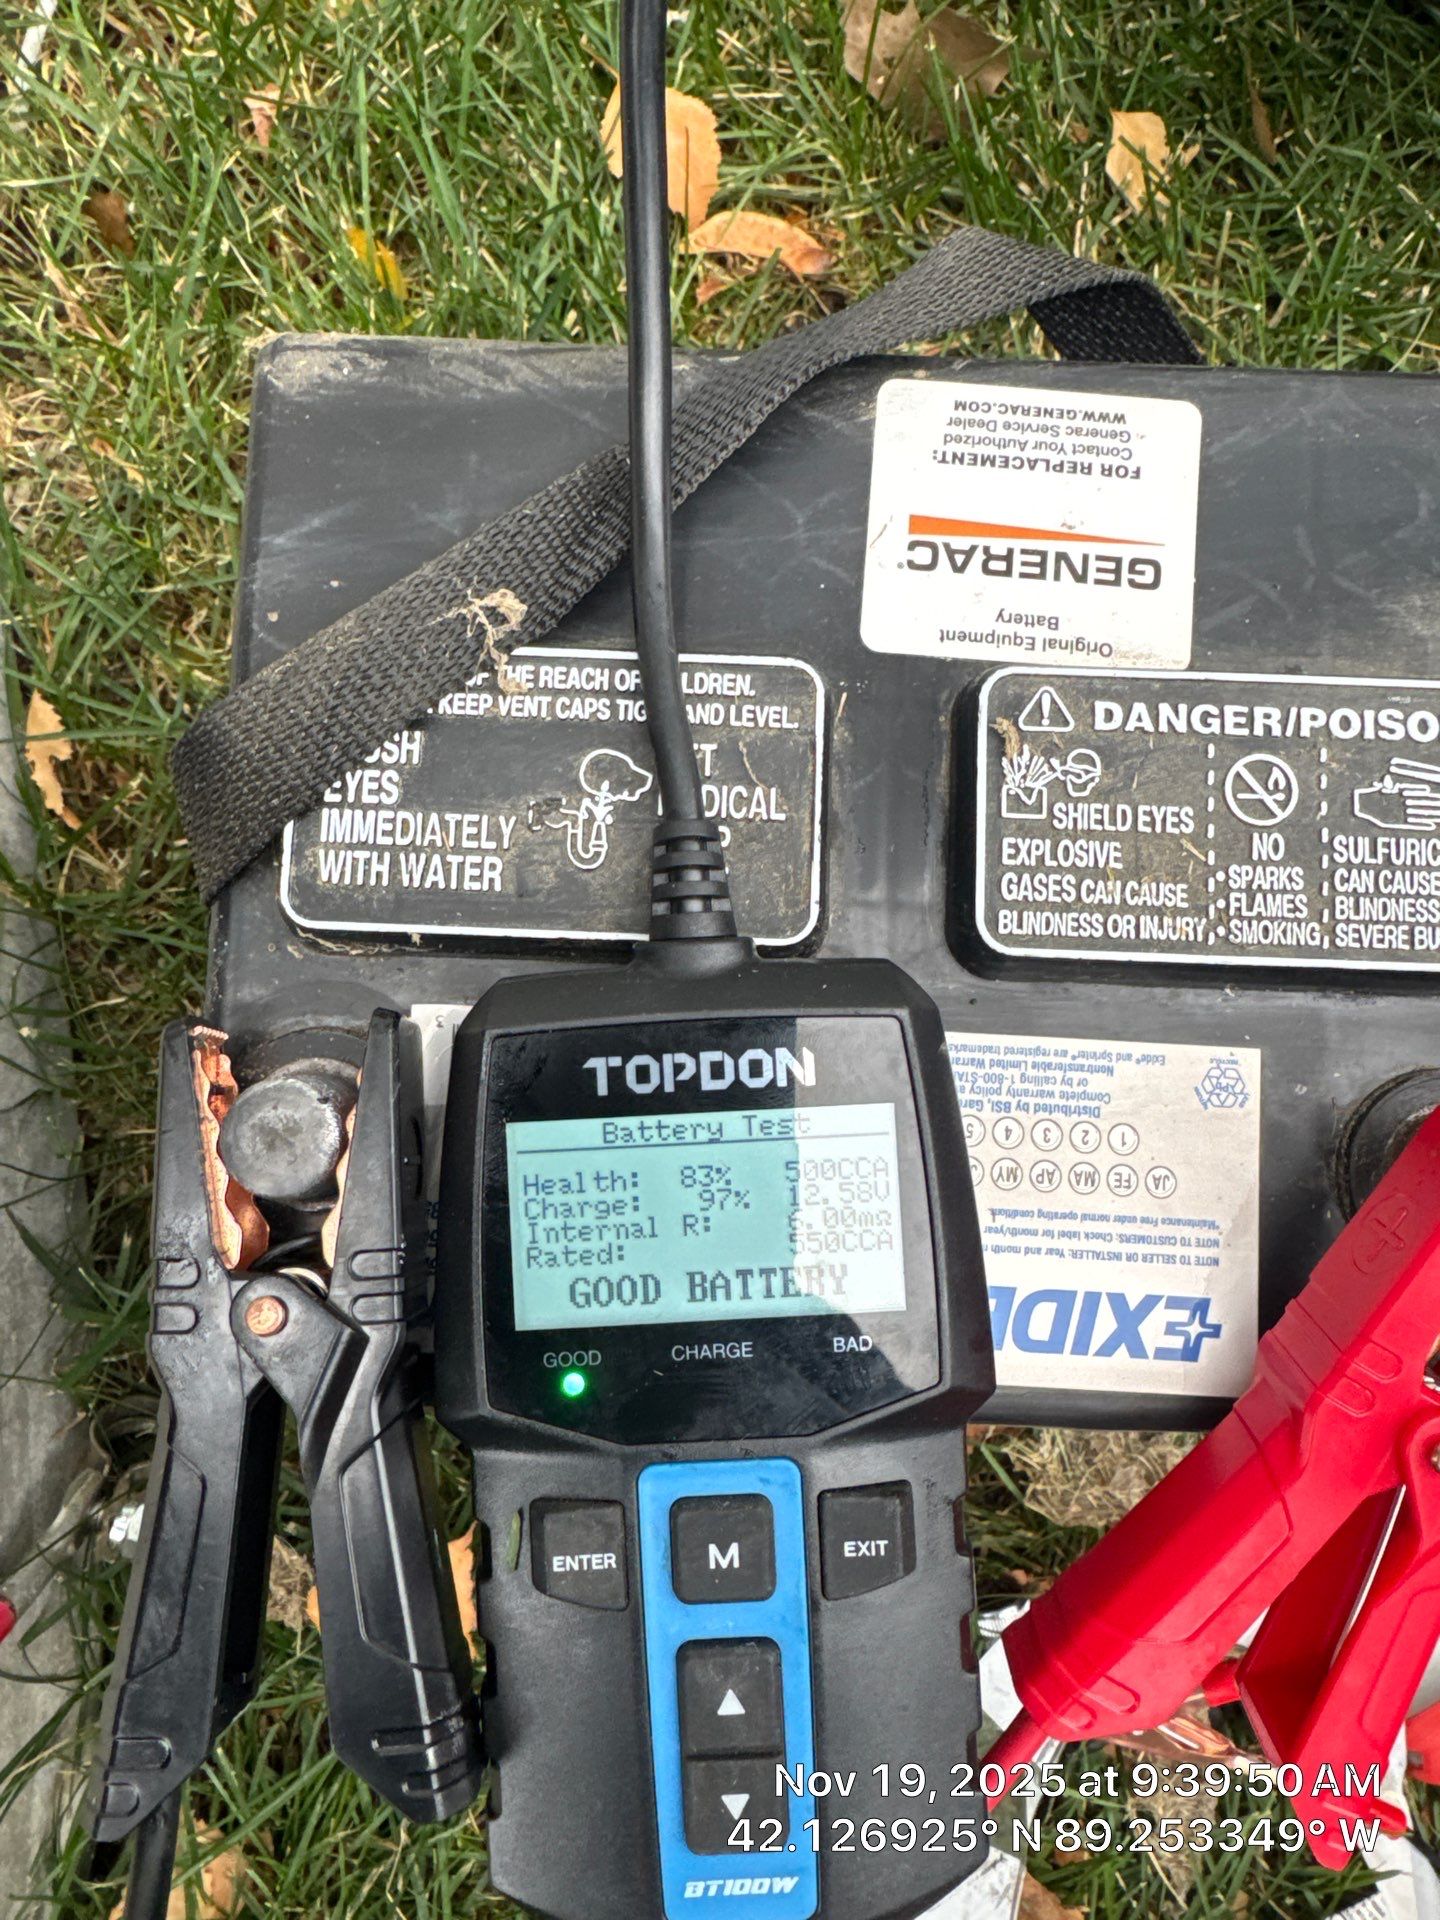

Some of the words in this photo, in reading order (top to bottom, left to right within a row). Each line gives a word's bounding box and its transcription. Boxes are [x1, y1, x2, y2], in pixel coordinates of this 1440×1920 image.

[954, 399, 1127, 424] WWW.GENERAC.COM
[946, 416, 997, 433] Dealer
[1002, 420, 1060, 437] Service
[943, 433, 1028, 451] Authorized
[1065, 426, 1131, 443] Generac
[1031, 440, 1067, 455] Your
[1072, 443, 1133, 460] Contact
[932, 449, 1093, 475] REPLACEMENT:
[1099, 464, 1141, 480] FOR
[996, 608, 1059, 630] Battery
[939, 629, 1036, 651] Equipment
[1042, 637, 1113, 657] Original
[539, 665, 609, 691] REACH
[681, 672, 756, 697] LDREN.
[438, 693, 493, 716] KEEP
[498, 695, 552, 719] VENT
[555, 697, 611, 721] CAPS
[616, 699, 648, 722] TIG
[729, 705, 799, 729] LEVEL.
[1093, 700, 1440, 743] DANGER/POISO
[657, 784, 787, 821] DICAL
[1052, 802, 1133, 832] SHIELD
[1137, 805, 1195, 834] EYES
[320, 807, 517, 850] IMMEDIATELY
[1001, 837, 1123, 869] EXPLOSIVE
[1252, 832, 1285, 862] NO
[1332, 834, 1440, 867] SULFURIC
[318, 849, 391, 887] WITH
[400, 851, 503, 892] WATER
[1227, 864, 1305, 892] SPARKS
[1000, 872, 1077, 902] GASES
[1080, 879, 1121, 906] CAN
[1125, 881, 1190, 908] CAUSE
[1333, 868, 1375, 895] CAN
[1378, 869, 1440, 897] CAUSE
[1228, 892, 1309, 919] FLAMES
[1334, 896, 1440, 924] BLINDNESS
[998, 909, 1104, 938] BLINDNESS
[1106, 915, 1136, 939] OR
[1140, 915, 1207, 941] INJURY
[1228, 919, 1321, 946] SMOKING
[1335, 923, 1411, 950] SEVERE
[1413, 925, 1440, 951] BU
[1004, 1045, 1051, 1057] registered
[1054, 1048, 1068, 1057] are
[1116, 1053, 1133, 1062] and
[582, 1046, 816, 1097] TOPDON
[989, 1057, 1028, 1071] Limited
[1031, 1060, 1115, 1076] Nontransferable
[954, 1070, 1016, 1085] 1-800-STA
[1020, 1072, 1057, 1087] calling
[1060, 1076, 1074, 1088] by
[1077, 1079, 1089, 1088] or
[970, 1081, 1002, 1097] policy
[1006, 1086, 1056, 1100] warranty
[1059, 1090, 1111, 1105] Complete
[988, 1099, 1012, 1113] BSI,
[1015, 1101, 1029, 1113] by
[1033, 1102, 1101, 1118] Distributed
[603, 1117, 724, 1145] Battery
[741, 1113, 811, 1138] Test
[1004, 1125, 1013, 1140] 4
[1043, 1127, 1052, 1142] 3
[1081, 1129, 1090, 1145] 2
[1120, 1131, 1128, 1147] 1
[523, 1169, 640, 1196] Health:
[680, 1163, 732, 1188] 83%
[785, 1156, 890, 1183] 500CCA
[996, 1166, 1019, 1183] MY
[1035, 1168, 1057, 1185] AP
[1073, 1169, 1097, 1187] MA
[1113, 1171, 1132, 1189] FE
[1152, 1174, 1170, 1190] JA
[523, 1194, 641, 1222] Charge:
[699, 1187, 751, 1212] 97%
[789, 1180, 890, 1207] 12.58V
[1037, 1208, 1079, 1221] operating
[1080, 1211, 1111, 1223] normal
[1112, 1213, 1138, 1224] under
[1139, 1215, 1158, 1226] Free
[527, 1215, 659, 1245] Internal
[683, 1213, 712, 1238] R:
[983, 1225, 1039, 1238] month/year
[1041, 1228, 1055, 1239] for
[1057, 1229, 1081, 1241] label
[1115, 1233, 1177, 1246] CUSTOMERS:
[1179, 1236, 1192, 1247] TO
[1195, 1238, 1220, 1248] NOTE
[527, 1243, 626, 1270] Rated:
[789, 1228, 893, 1255] 550CCA
[991, 1243, 1022, 1255] month
[1024, 1244, 1043, 1256] and
[1044, 1247, 1066, 1258] Year
[1068, 1248, 1123, 1261] INSTALLER:
[1126, 1251, 1139, 1262] OR
[1141, 1253, 1177, 1264] SELLER
[1179, 1255, 1192, 1265] TO
[1194, 1256, 1220, 1267] NOTE
[569, 1273, 662, 1309] GOOD
[687, 1263, 848, 1303] BATTERY
[671, 1341, 754, 1362] CHARGE
[833, 1335, 873, 1354] BAD
[543, 1350, 602, 1369] GOOD
[708, 1543, 740, 1569] M
[843, 1539, 889, 1558] EXIT
[552, 1552, 617, 1572] ENTER
[683, 1875, 799, 1899] BT100W
